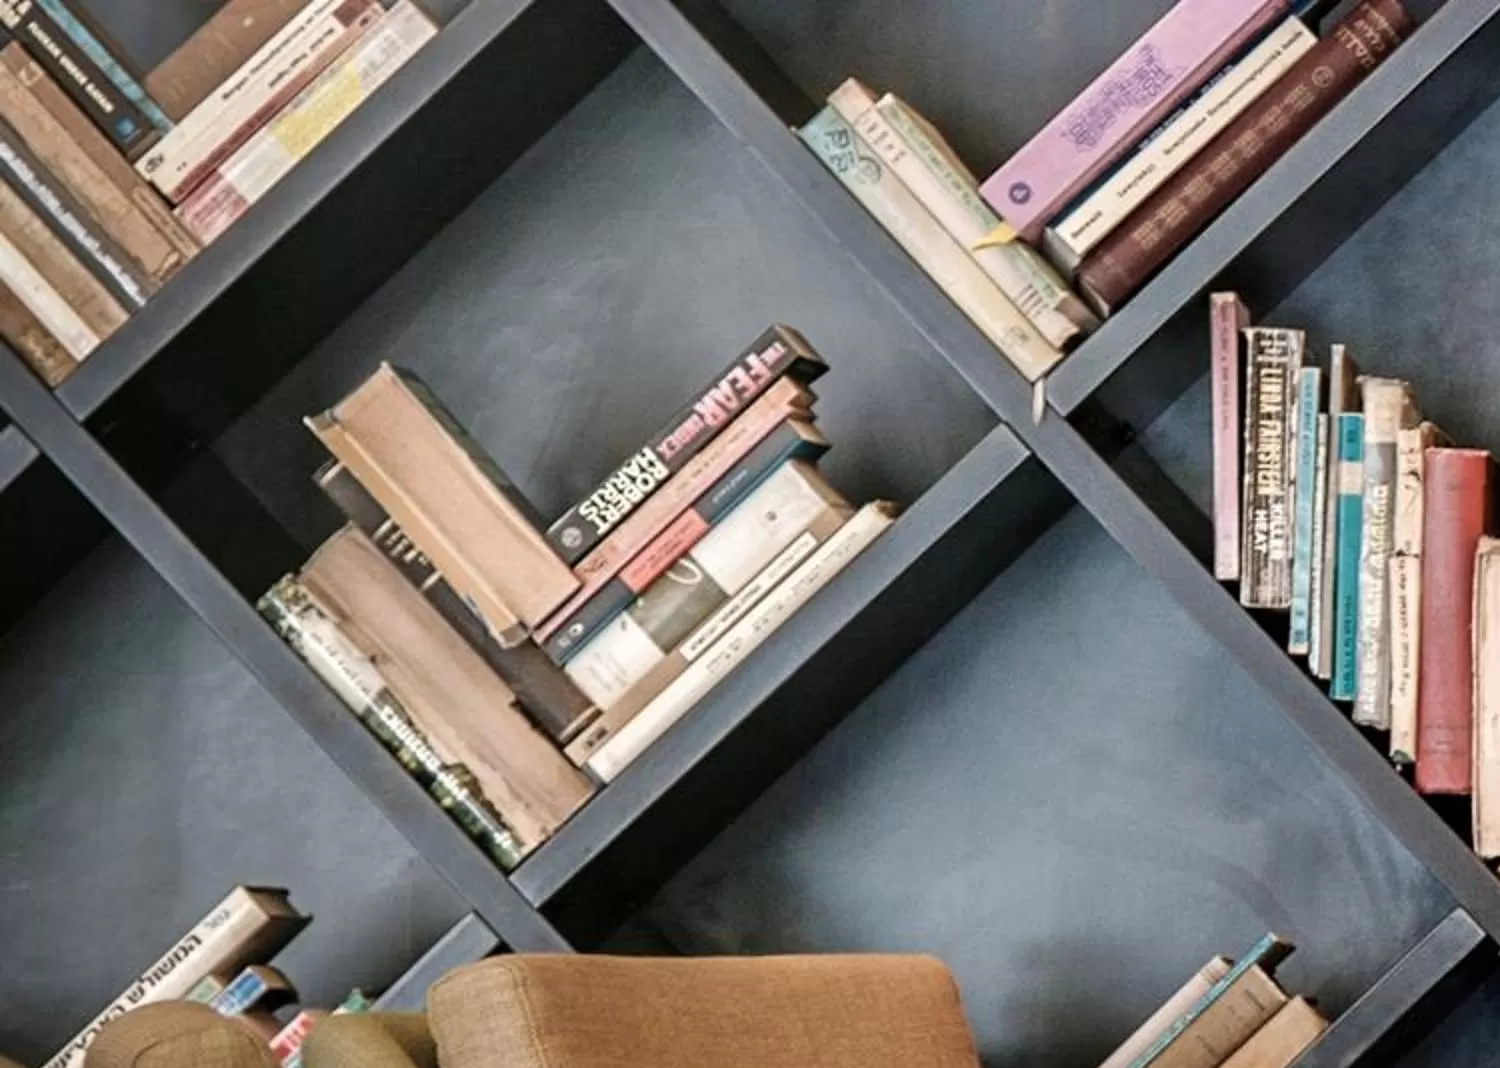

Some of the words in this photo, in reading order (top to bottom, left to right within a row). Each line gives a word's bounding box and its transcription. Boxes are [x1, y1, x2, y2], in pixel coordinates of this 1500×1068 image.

[690, 350, 774, 431] FEAR
[1258, 367, 1284, 413] LINDA
[575, 444, 658, 523] HARRIS
[1254, 419, 1284, 495] FAIRSTEIN
[588, 457, 670, 536] ROBERT
[1252, 509, 1267, 552] HEAT
[1268, 500, 1285, 560] KILLER
